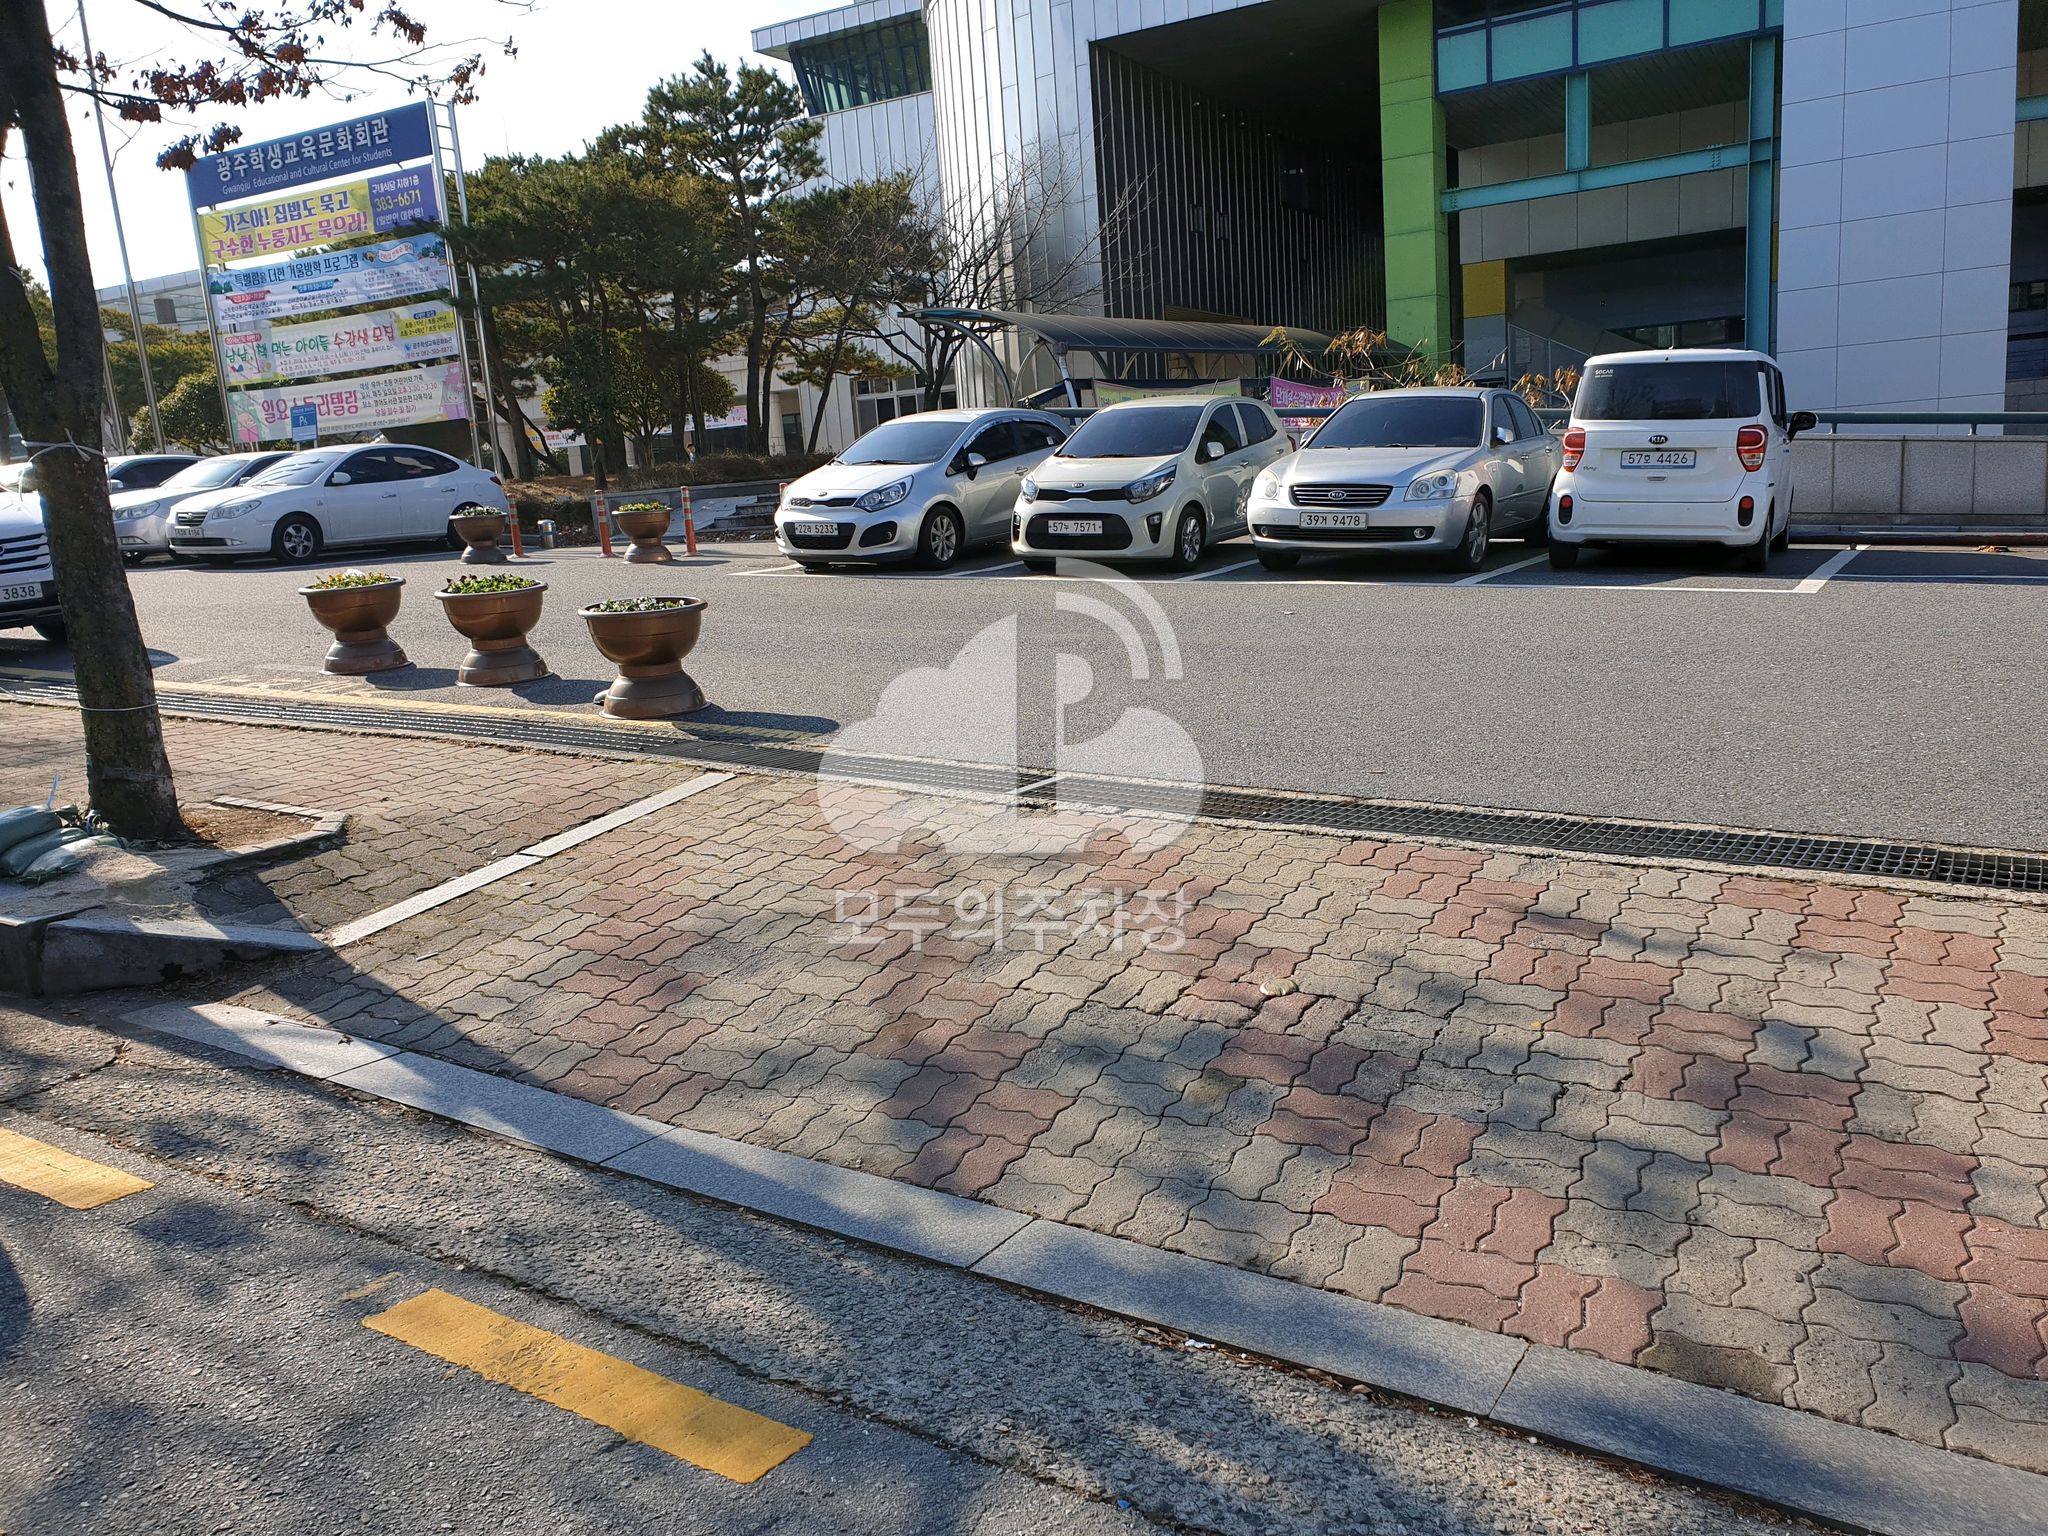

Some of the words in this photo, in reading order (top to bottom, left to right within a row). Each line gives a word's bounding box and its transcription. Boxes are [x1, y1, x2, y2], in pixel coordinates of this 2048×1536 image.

[216, 116, 388, 182] 광주학생교육문화회관
[222, 181, 251, 195] Gwangju
[253, 172, 289, 188] Educational
[290, 166, 302, 179] and
[302, 162, 328, 176] Cultural
[329, 158, 351, 170] Center
[351, 155, 362, 166] for
[363, 148, 393, 163] Students
[372, 180, 396, 194] 구내식당
[374, 189, 421, 212] 383-6671
[221, 207, 271, 234] 가즈아!
[273, 197, 317, 224] 집밥도
[320, 191, 350, 213] 묵고
[212, 234, 254, 258] 구수한
[257, 222, 315, 250] 누룽지도
[318, 211, 368, 238] 묵으러!
[235, 270, 267, 287] 특별함을
[268, 267, 285, 282] 더한
[323, 253, 359, 272] 프로그램
[256, 342, 268, 358] 책
[271, 341, 292, 356] 먹는
[296, 335, 329, 352] 아이들
[334, 327, 369, 348] 수강생
[372, 323, 395, 342] 모집
[1627, 453, 1651, 465] 57호
[1656, 453, 1688, 465] 4426
[815, 524, 834, 534] 5233
[1073, 522, 1096, 532] 7571
[1306, 514, 1327, 526] 39거
[1332, 515, 1360, 527] 9478
[2, 585, 36, 600] 3838
